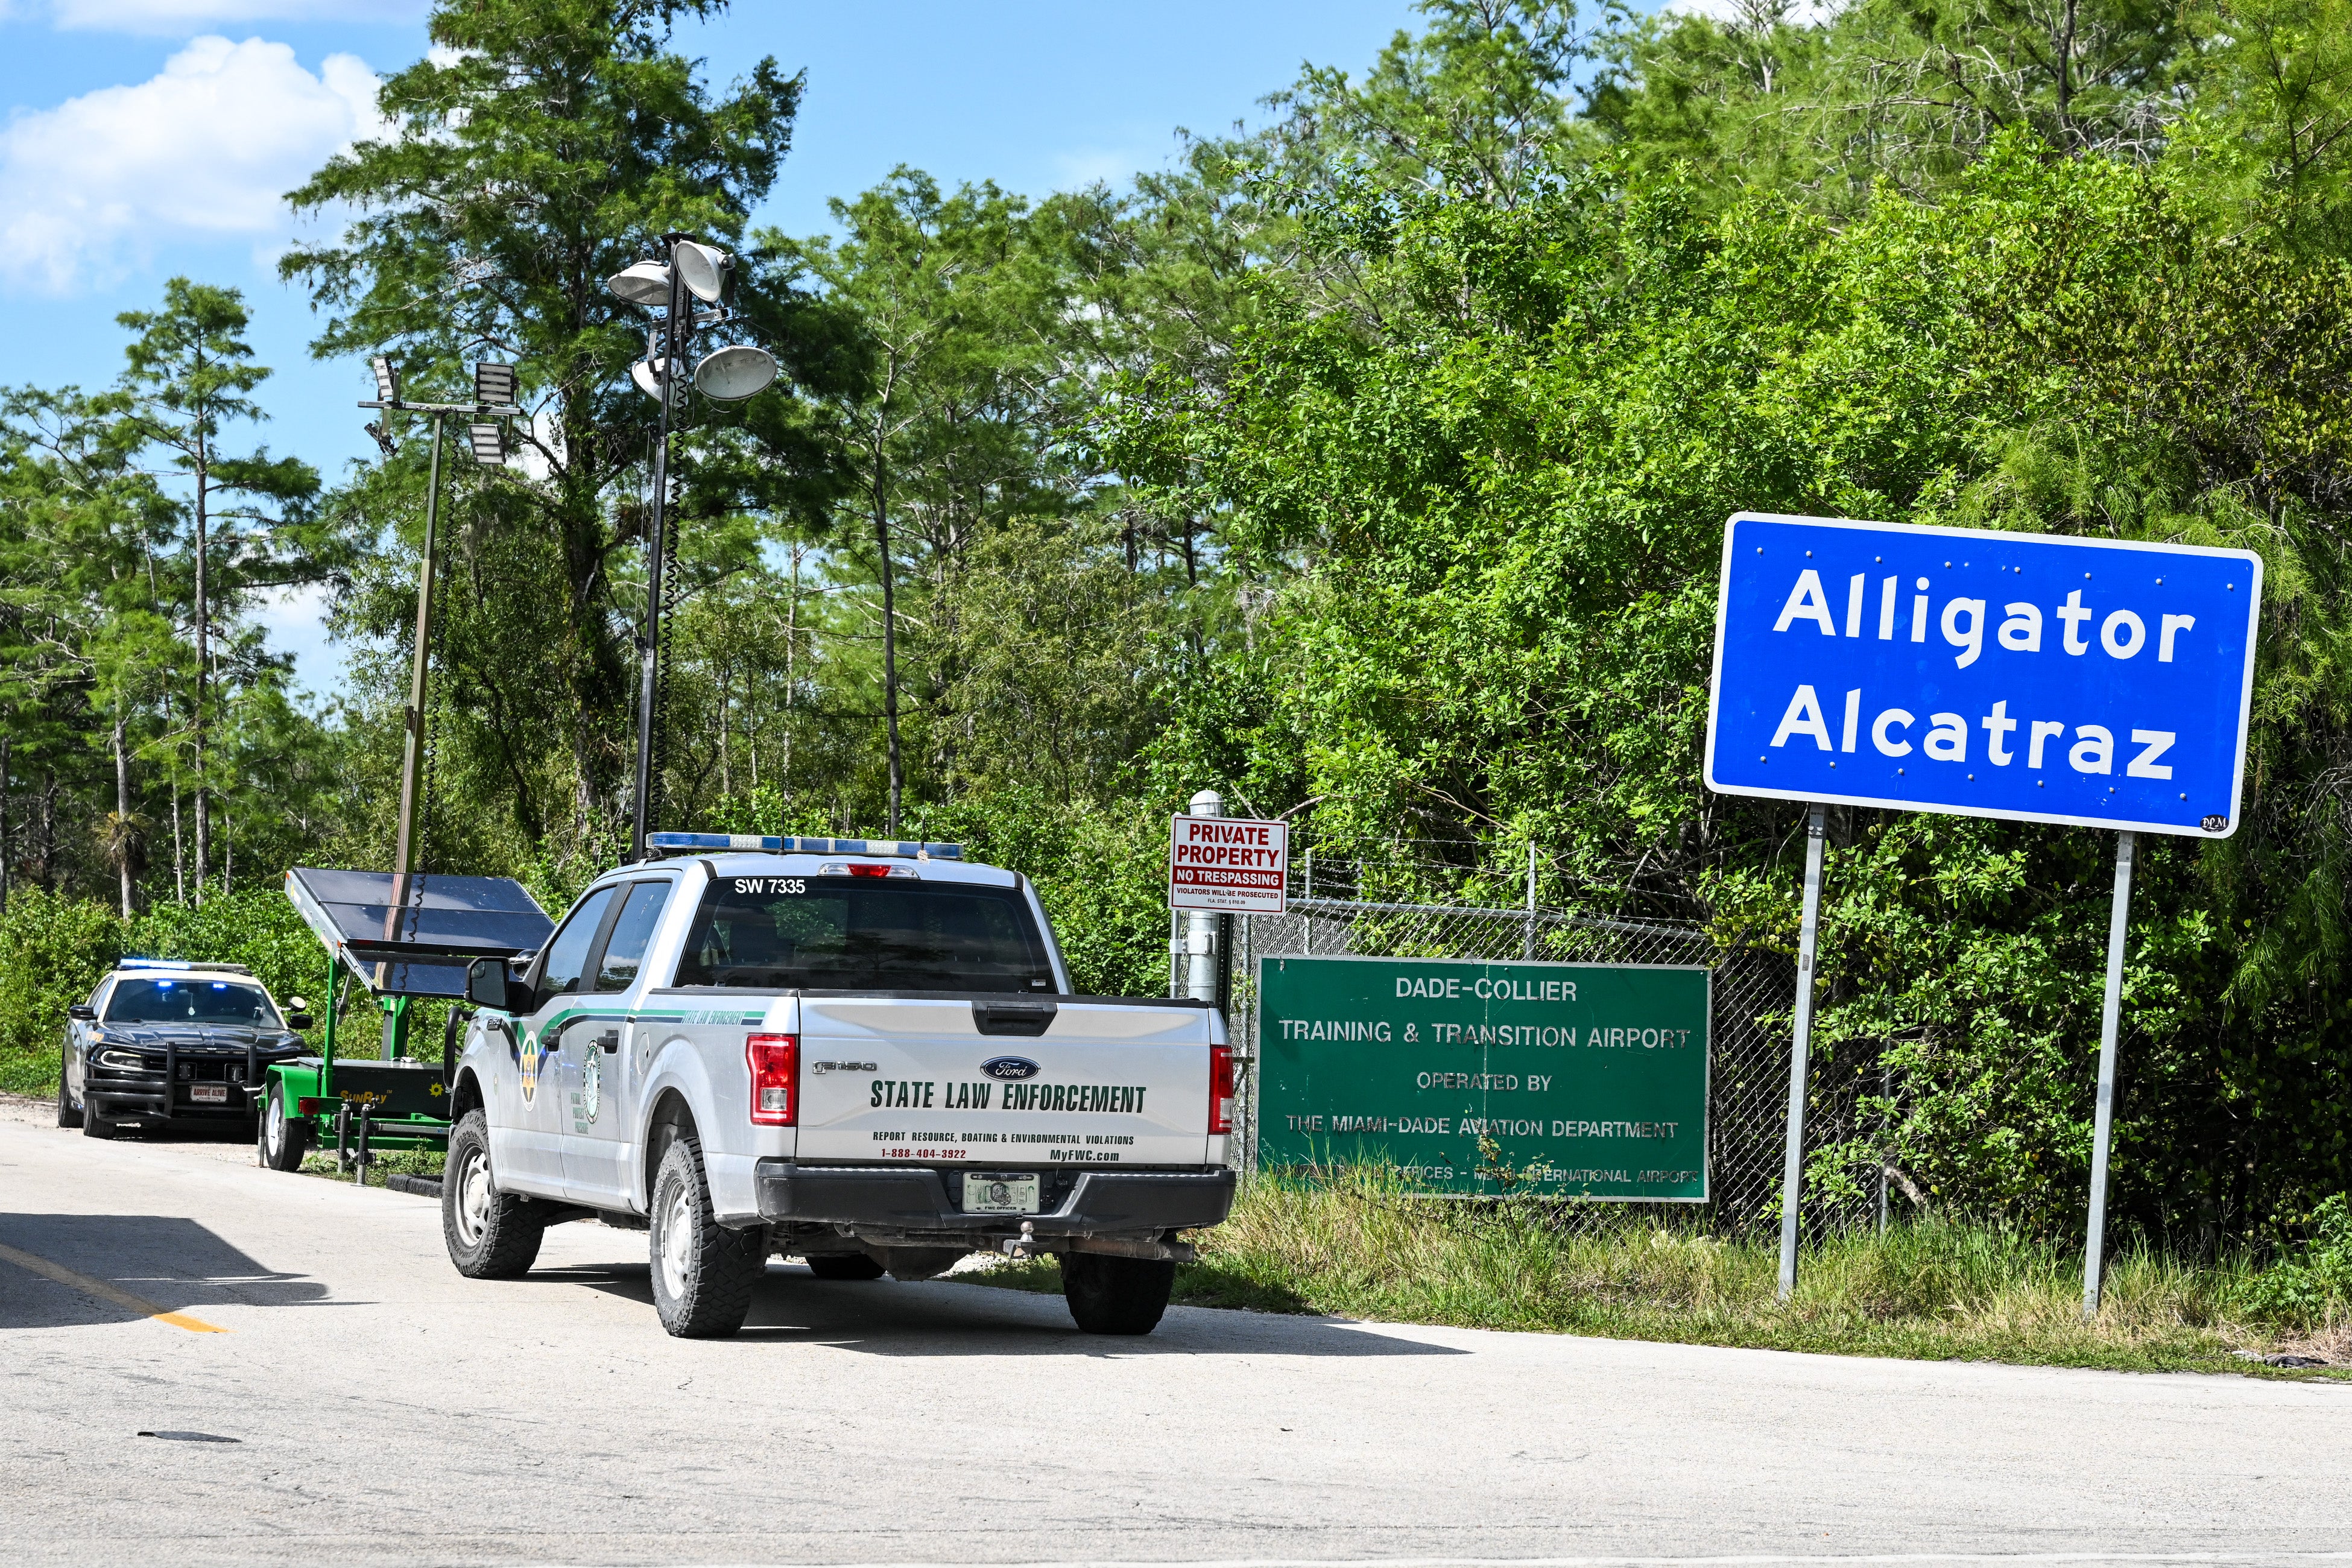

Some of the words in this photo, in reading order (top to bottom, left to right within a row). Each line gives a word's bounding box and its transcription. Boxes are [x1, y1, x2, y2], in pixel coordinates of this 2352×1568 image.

[1772, 569, 2196, 669] Alligator
[1769, 684, 2176, 780] Alcatraz
[1189, 824, 1269, 846] PRIVATE
[1178, 845, 1279, 867] PROPERTY
[735, 879, 763, 893] SW
[768, 879, 805, 893] 7335
[1177, 869, 1193, 882] NO
[1197, 870, 1279, 886] TRESPASSING
[1396, 978, 1577, 1001] DADE-COLLIER
[1279, 1019, 1392, 1042] TRAINING
[1403, 1022, 1420, 1043] &
[1431, 1023, 1576, 1047] TRANSITION
[1587, 1027, 1691, 1049] AIRPORT
[995, 1061, 1028, 1076] Ford
[1417, 1072, 1519, 1090] OPERATED
[1528, 1075, 1553, 1091] BY
[194, 1088, 210, 1096] ARRIVE
[870, 1080, 934, 1108] STATE
[945, 1082, 991, 1110] LAW
[1002, 1084, 1146, 1113] ENFORCEMENT
[1285, 1114, 1323, 1132] THE
[1332, 1116, 1450, 1134] MIAMI-DADE
[1458, 1118, 1543, 1137] AVIATION
[1552, 1120, 1679, 1139] DEPARTMENT
[873, 1131, 906, 1141] REPORT
[912, 1132, 958, 1143] RESOURCE,
[961, 1133, 997, 1142] BOATING
[1001, 1134, 1007, 1143] &
[1011, 1134, 1081, 1145] ENVIRONMENTAL
[1085, 1135, 1134, 1145] VIOLATIONS
[881, 1148, 966, 1159] 1-888-404-3922
[1050, 1149, 1120, 1162] MyFWC.com
[1637, 1170, 1699, 1183] AIRPORT
